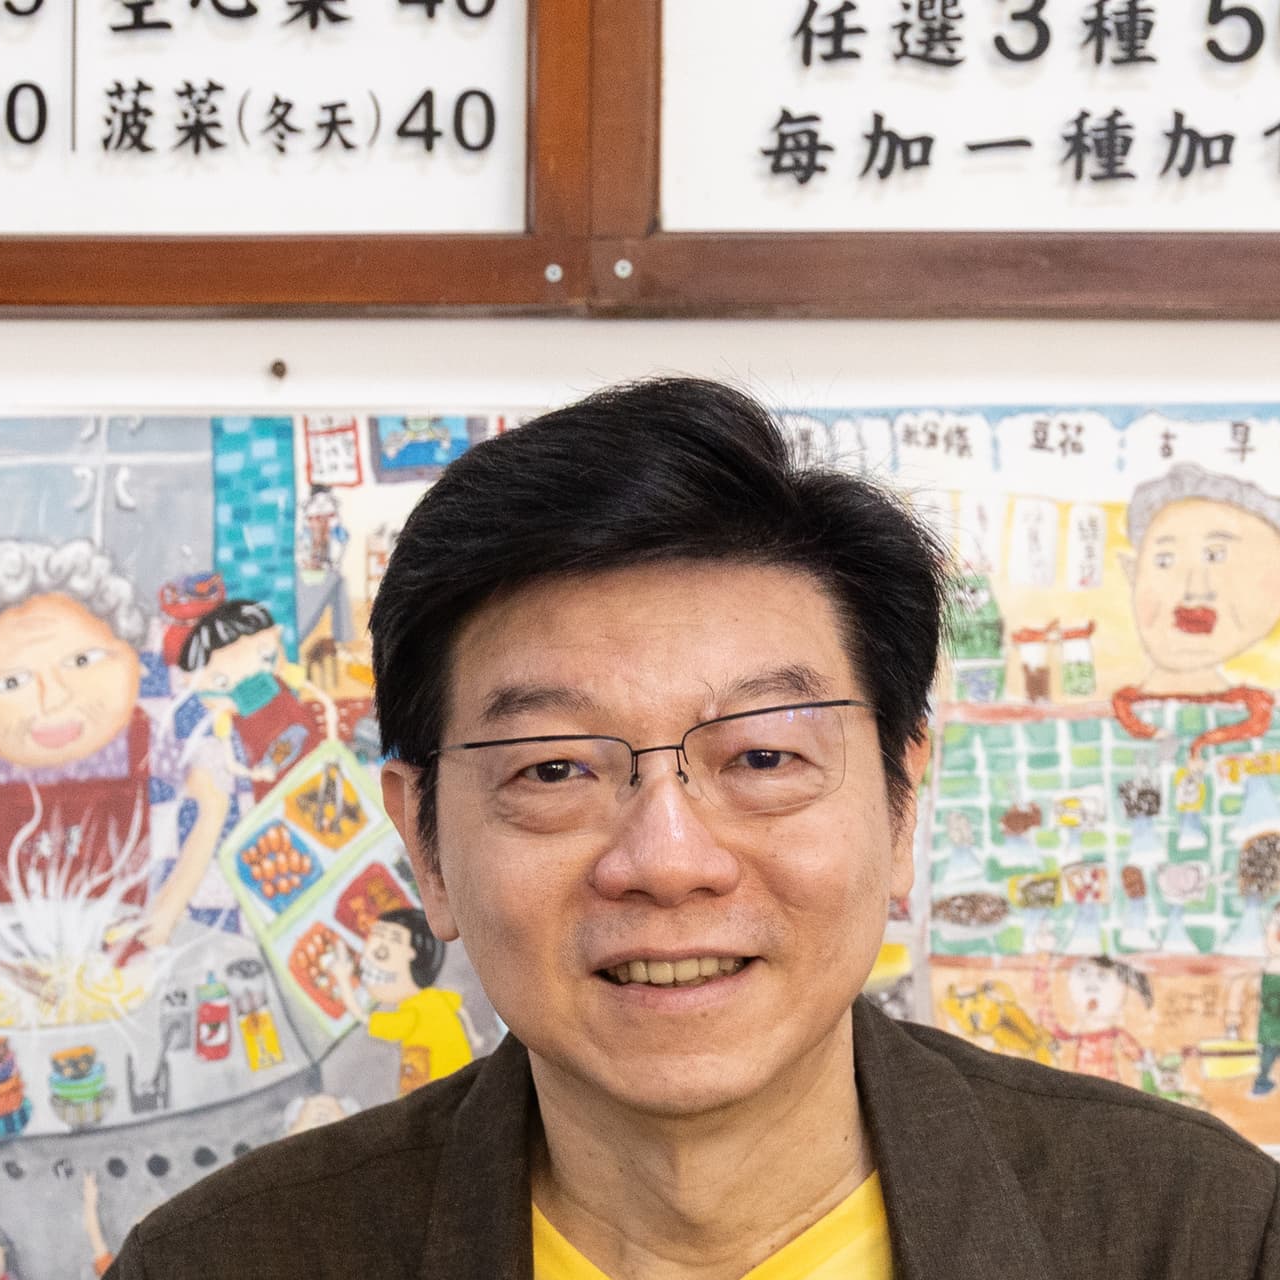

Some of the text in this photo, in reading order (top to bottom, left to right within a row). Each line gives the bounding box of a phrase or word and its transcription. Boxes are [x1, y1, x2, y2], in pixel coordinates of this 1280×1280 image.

[102, 80, 497, 155] 菠菜(冬天) 40
[1027, 419, 1085, 458] 豆花
